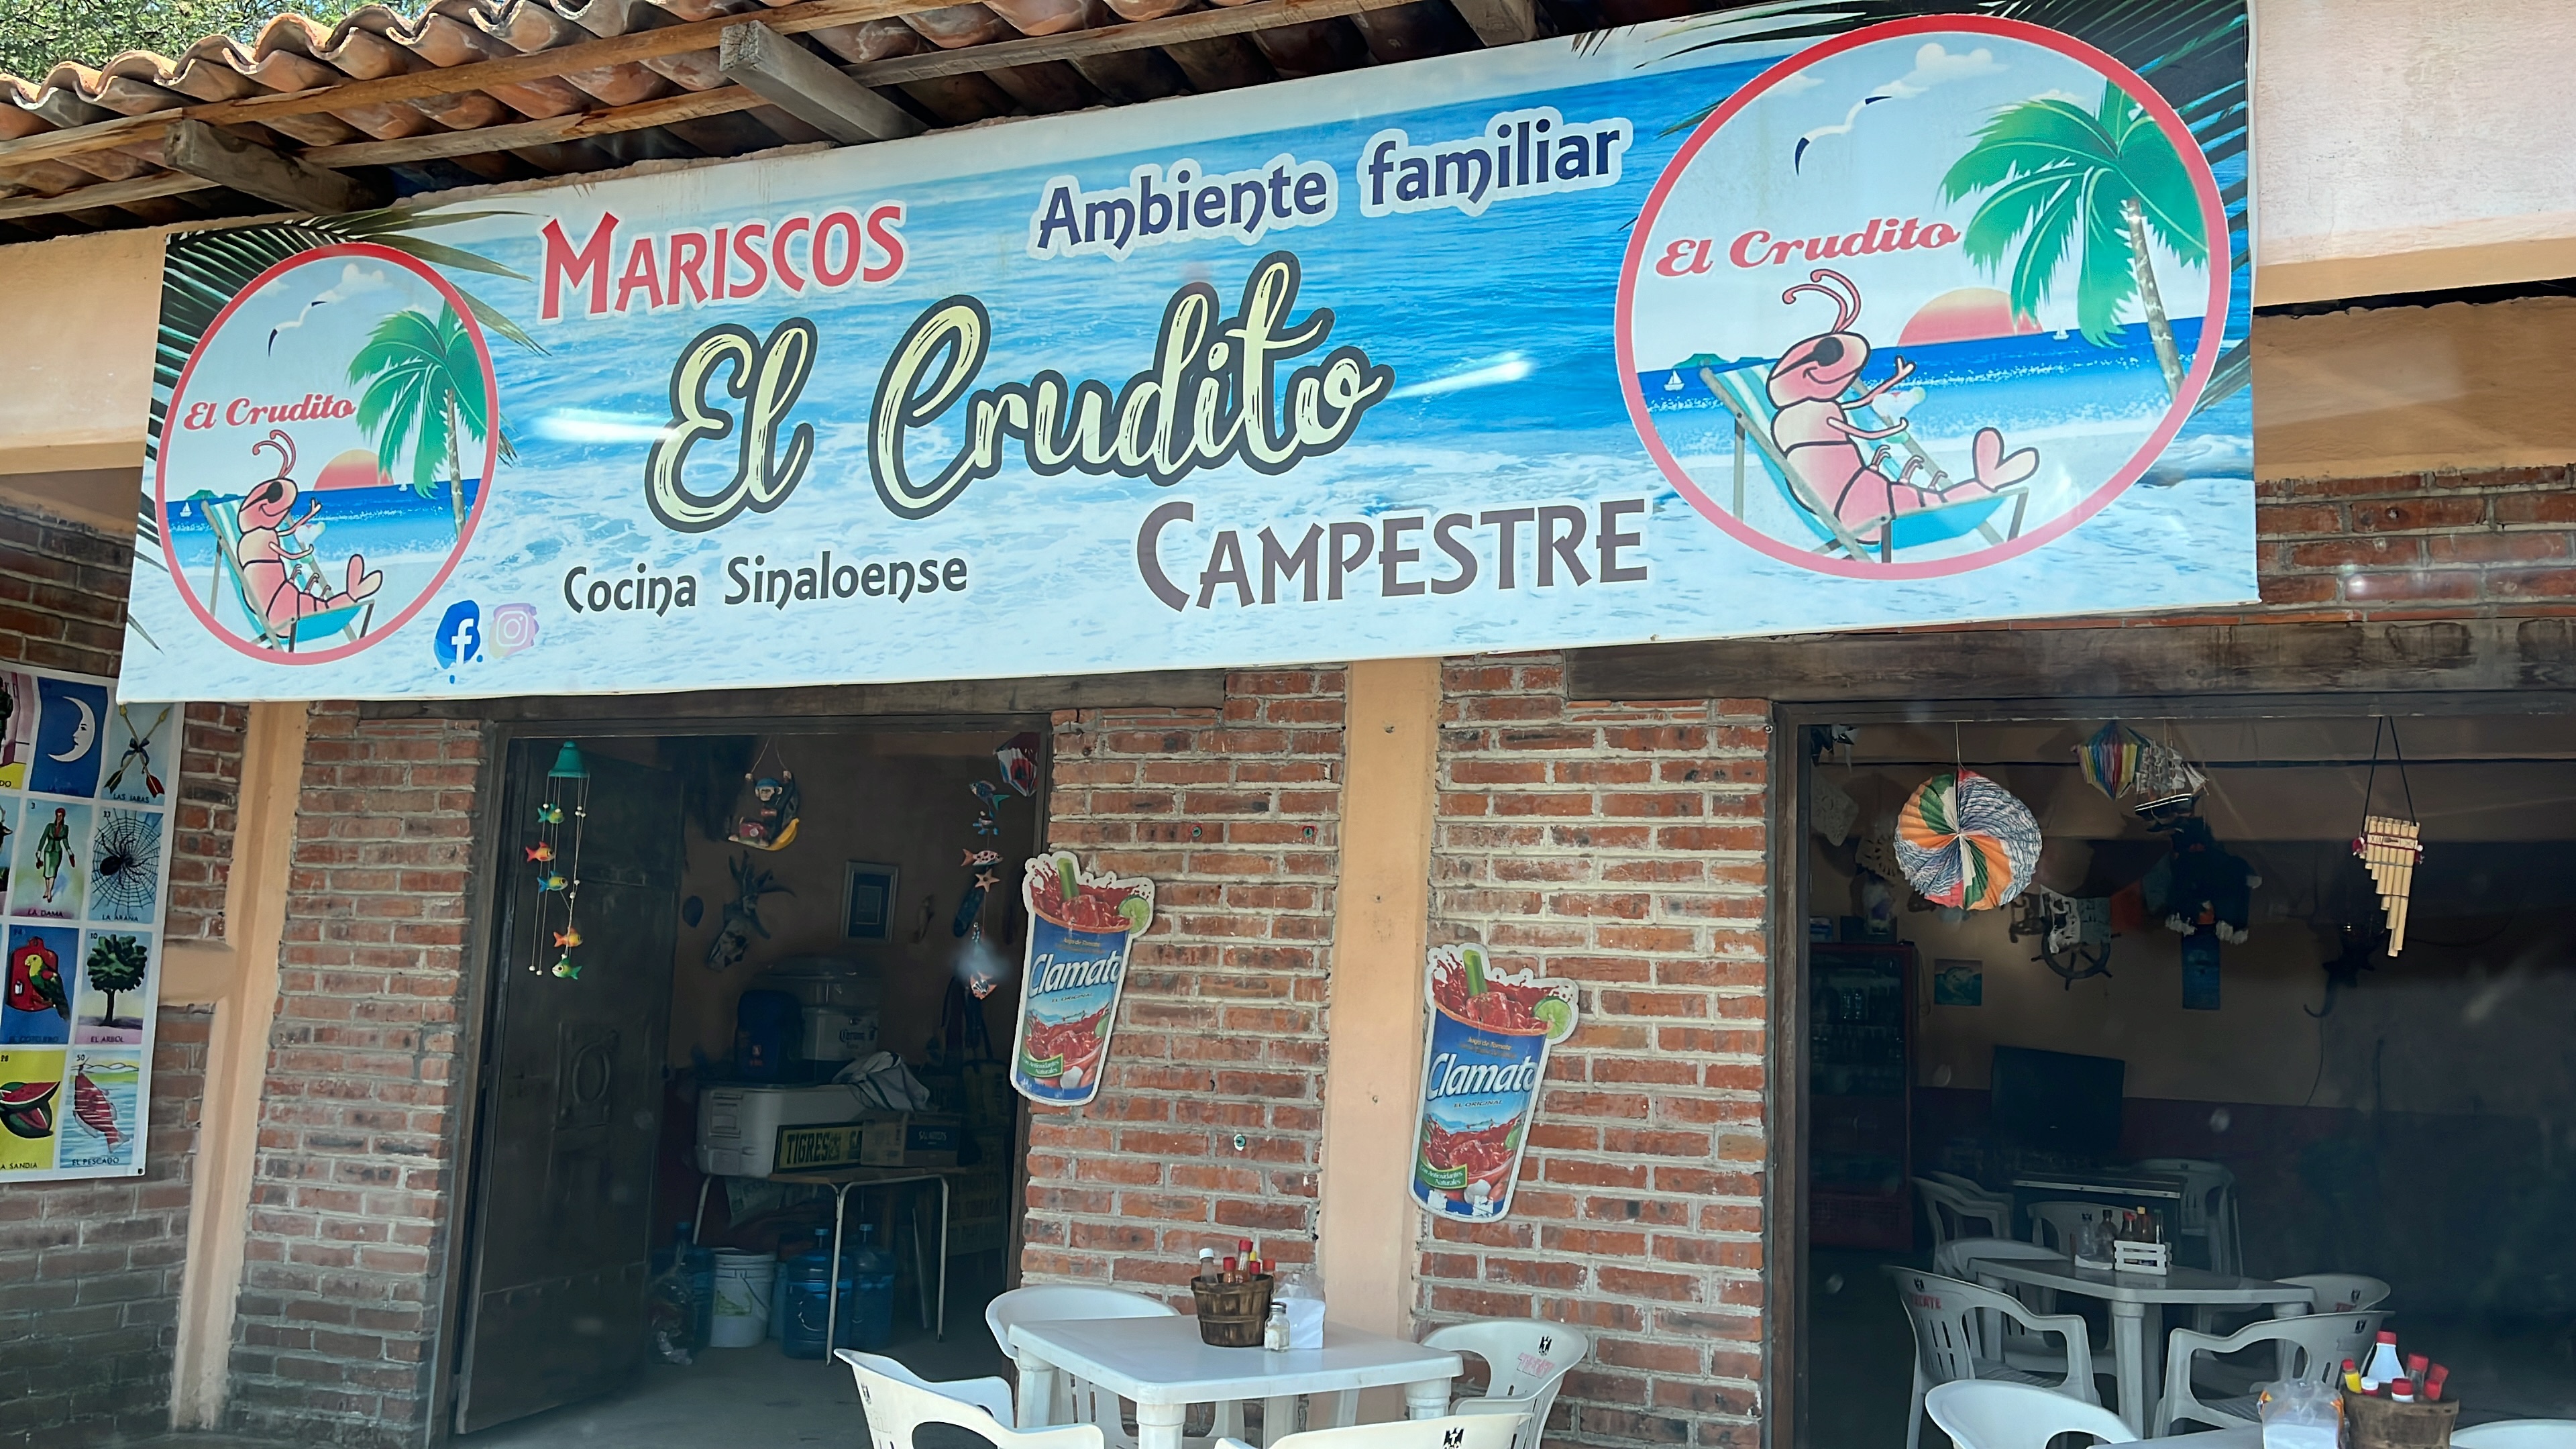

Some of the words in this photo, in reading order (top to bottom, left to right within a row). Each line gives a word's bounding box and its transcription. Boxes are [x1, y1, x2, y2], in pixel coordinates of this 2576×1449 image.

[1038, 165, 1328, 249] Ambiente
[1368, 119, 1620, 205] familiar
[1656, 239, 1713, 277] El
[1729, 217, 1962, 268] Crudito
[645, 317, 818, 533] El
[867, 250, 1396, 520] Crudito
[183, 400, 216, 431] El
[226, 393, 356, 427] Crudito
[564, 562, 696, 616] Cocina
[724, 550, 967, 610] Sinaloense
[113, 793, 126, 801] LAS
[40, 910, 64, 918] DAMA
[1028, 950, 1123, 998] Clamato
[76, 1053, 85, 1061] 50
[90, 1035, 99, 1043] EL
[1426, 1053, 1539, 1101] Clamato
[72, 1159, 80, 1167] EL
[83, 1157, 119, 1166] PESCADO
[786, 1131, 831, 1165] TIGRES
